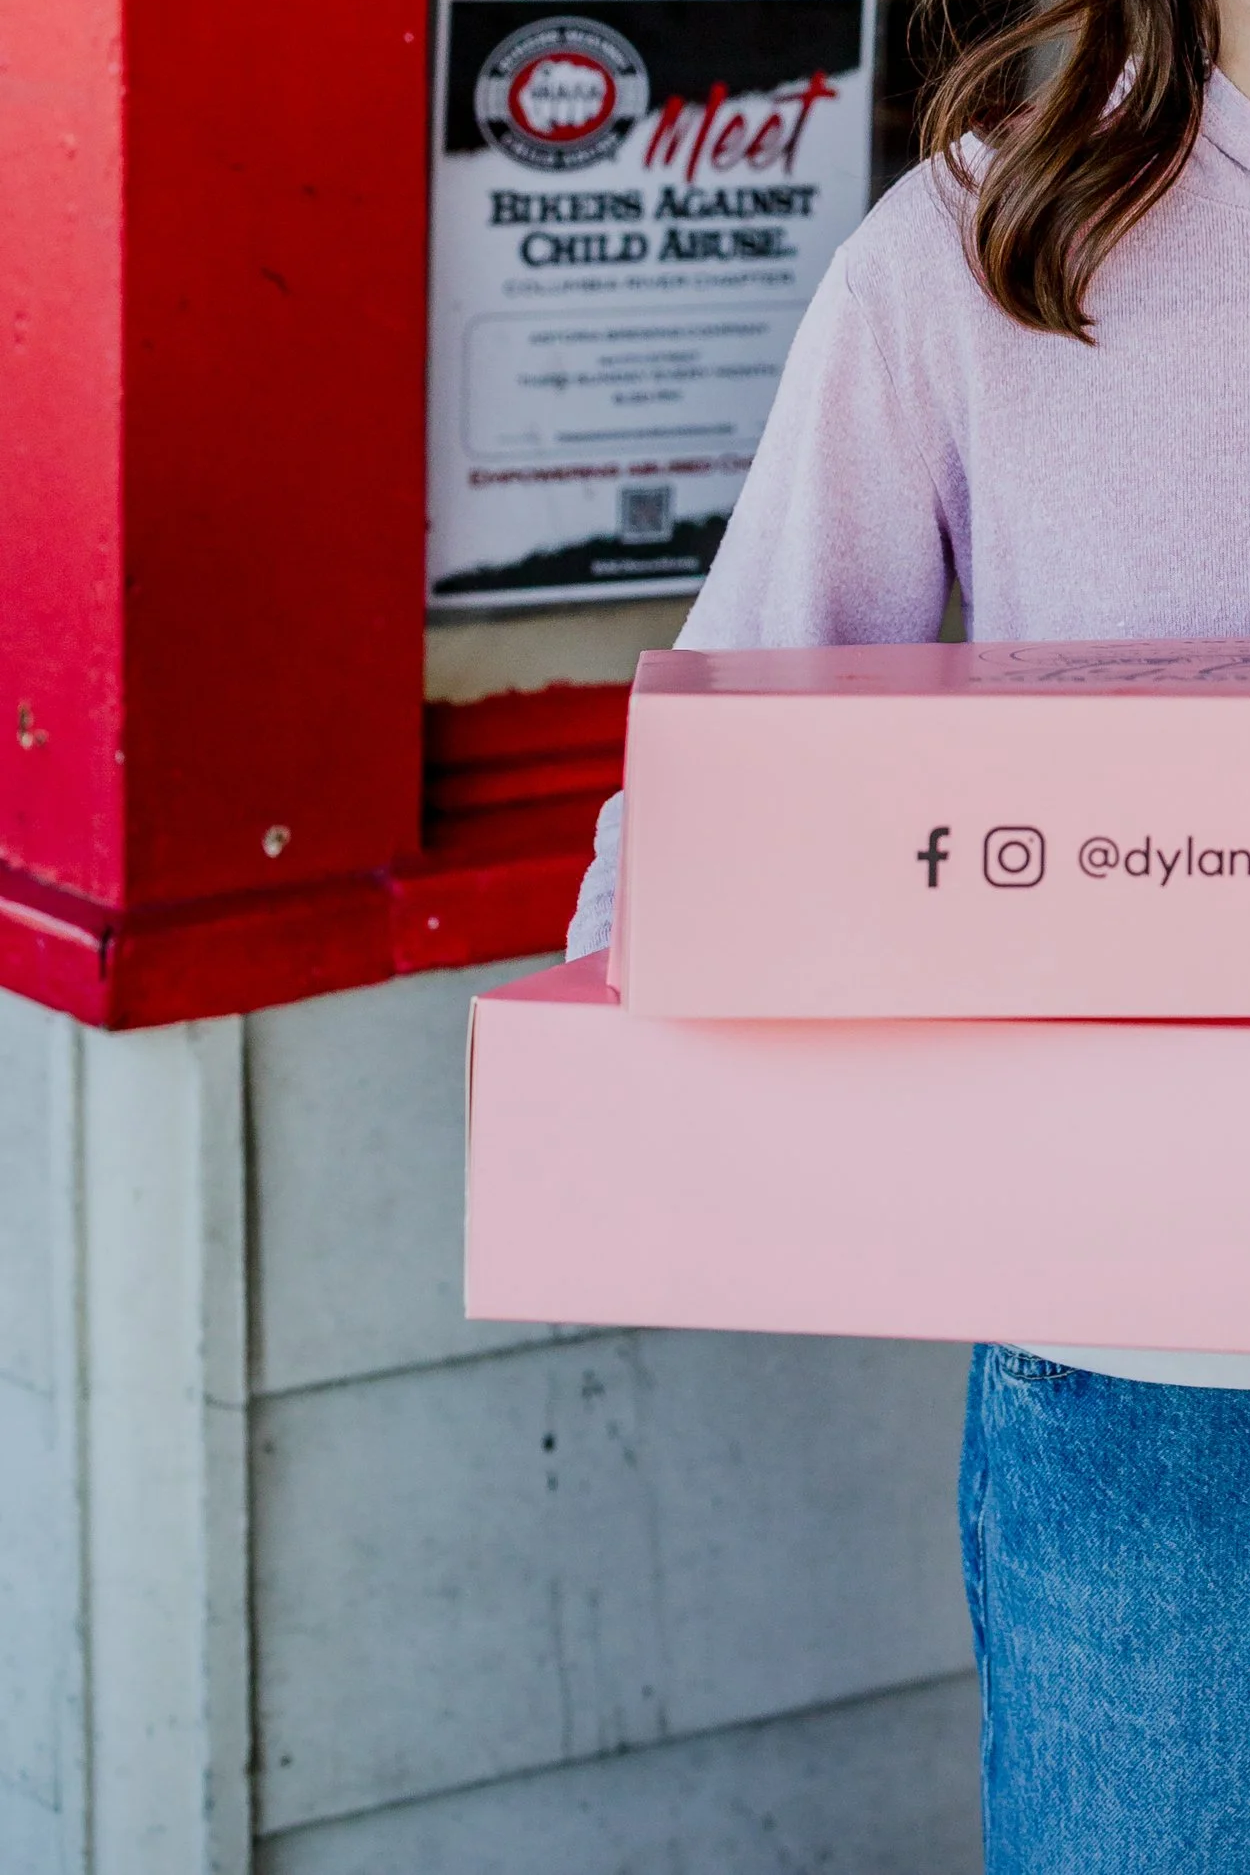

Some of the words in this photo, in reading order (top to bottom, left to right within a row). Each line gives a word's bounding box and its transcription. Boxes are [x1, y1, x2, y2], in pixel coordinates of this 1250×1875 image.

[641, 71, 838, 183] Meet
[491, 190, 643, 224] BIKERS
[655, 185, 818, 220] AGAINST
[520, 233, 647, 265] CHILD
[661, 229, 796, 261] ABUSE
